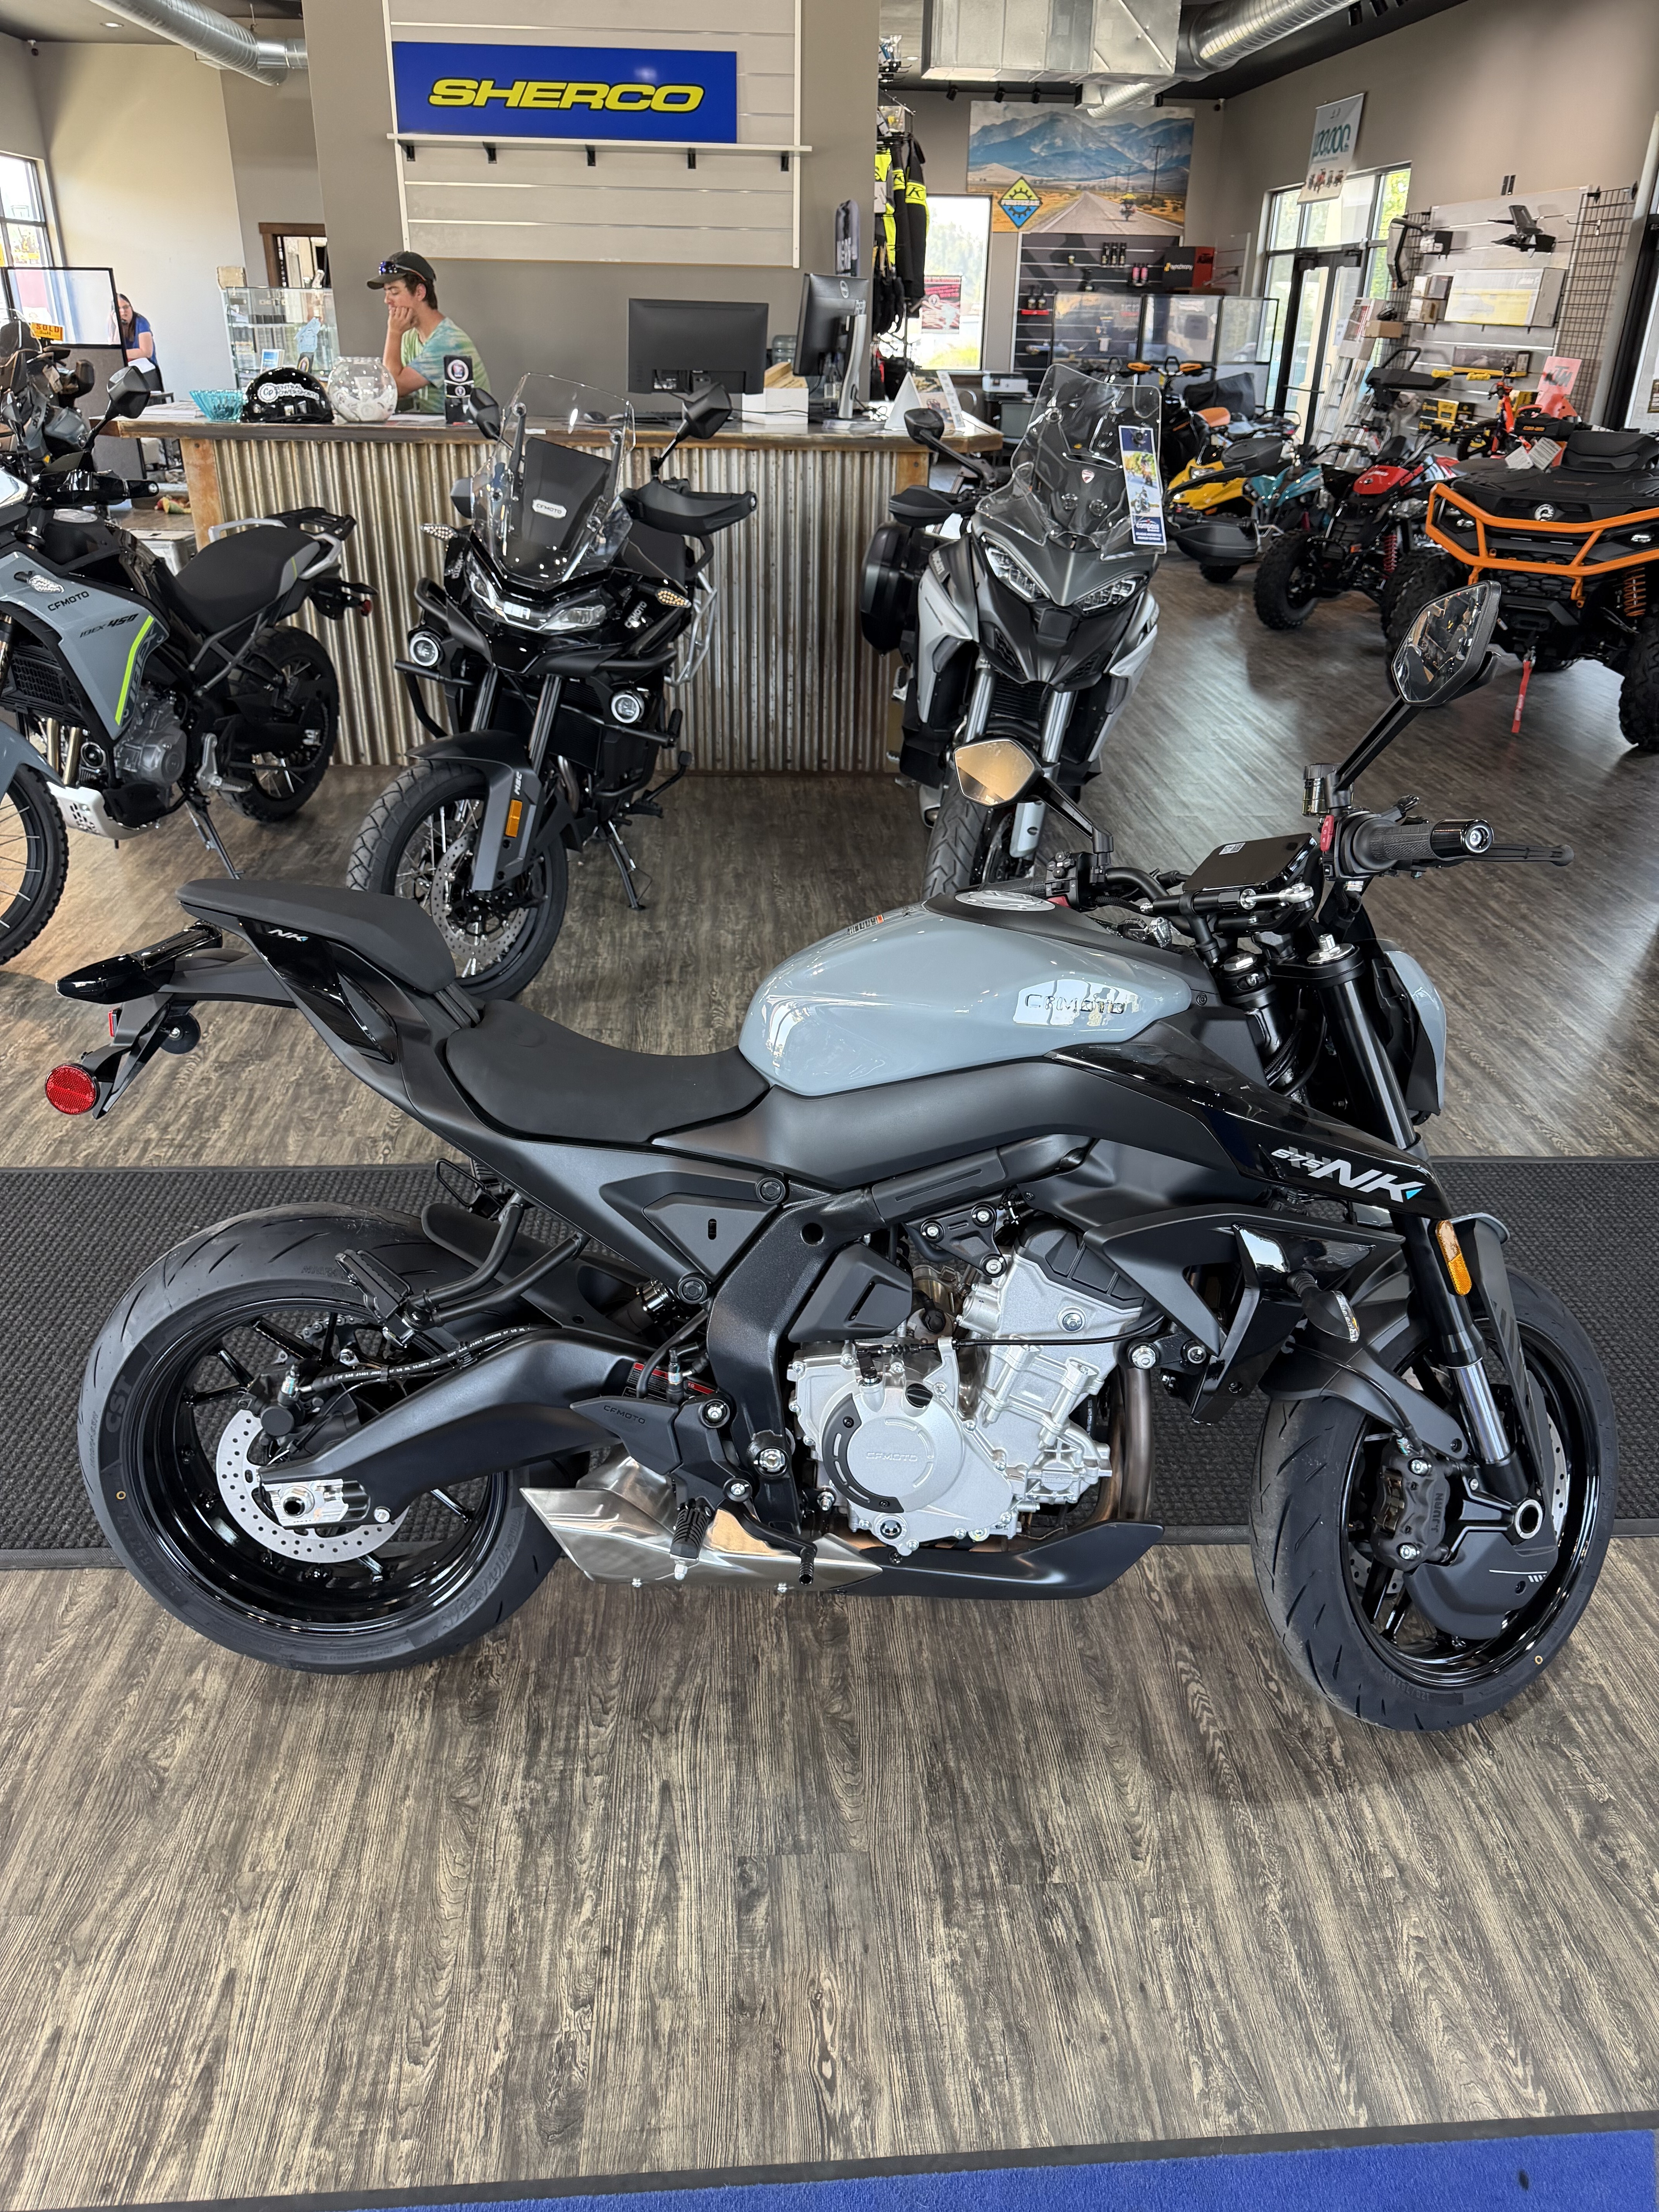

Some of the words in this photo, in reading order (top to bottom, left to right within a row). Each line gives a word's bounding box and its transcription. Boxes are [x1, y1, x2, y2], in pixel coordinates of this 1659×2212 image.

[428, 77, 704, 112] SHERCO
[36, 323, 59, 333] SOLD
[48, 591, 89, 611] CFMOTO
[80, 624, 106, 638] IBEX
[106, 613, 139, 627] 450
[268, 929, 309, 942] NK
[1271, 1149, 1326, 1169] 675
[1307, 1159, 1427, 1203] NK
[469, 1339, 483, 1348] J1401
[105, 1374, 132, 1432] CST
[604, 1405, 646, 1424] CFMOTO
[866, 1451, 918, 1462] CFMOTO
[1431, 1492, 1444, 1533] J.JUAN
